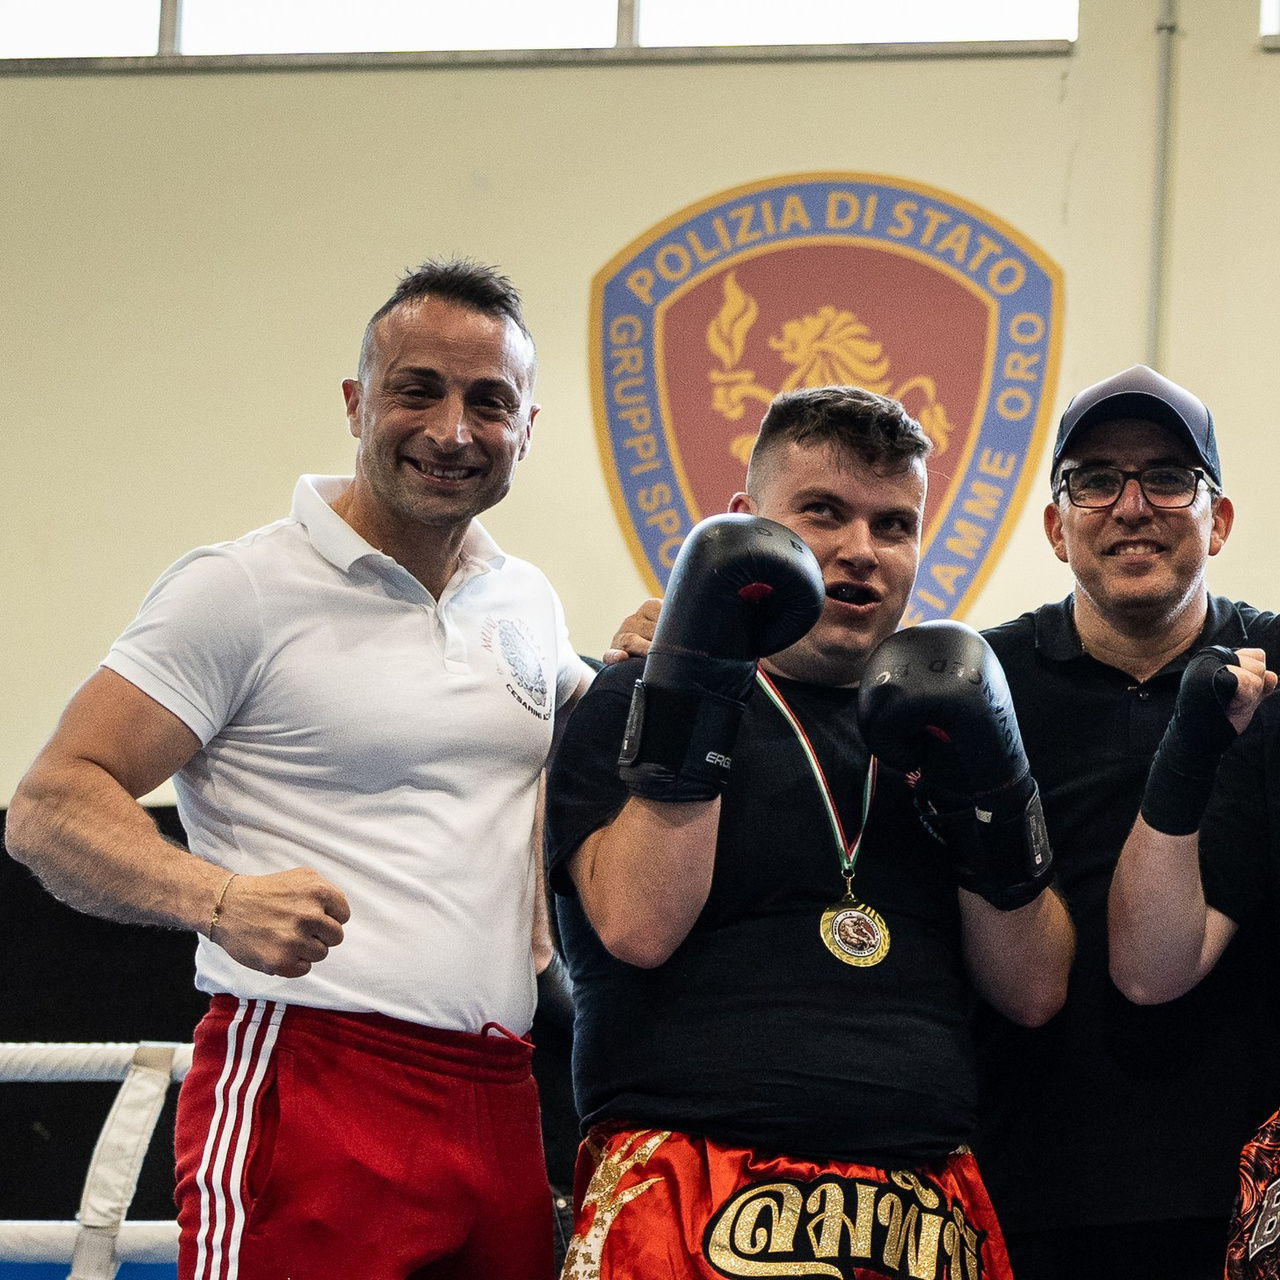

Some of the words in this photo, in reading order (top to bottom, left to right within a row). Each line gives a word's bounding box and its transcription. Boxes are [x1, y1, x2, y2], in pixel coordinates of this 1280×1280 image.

[625, 194, 811, 305] POLIZIA
[825, 191, 876, 230] DI
[887, 201, 1026, 296] STATO
[996, 311, 1044, 421] ORO
[608, 314, 661, 476] GRUPPI
[638, 483, 682, 570] SPO
[705, 751, 731, 769] ERG
